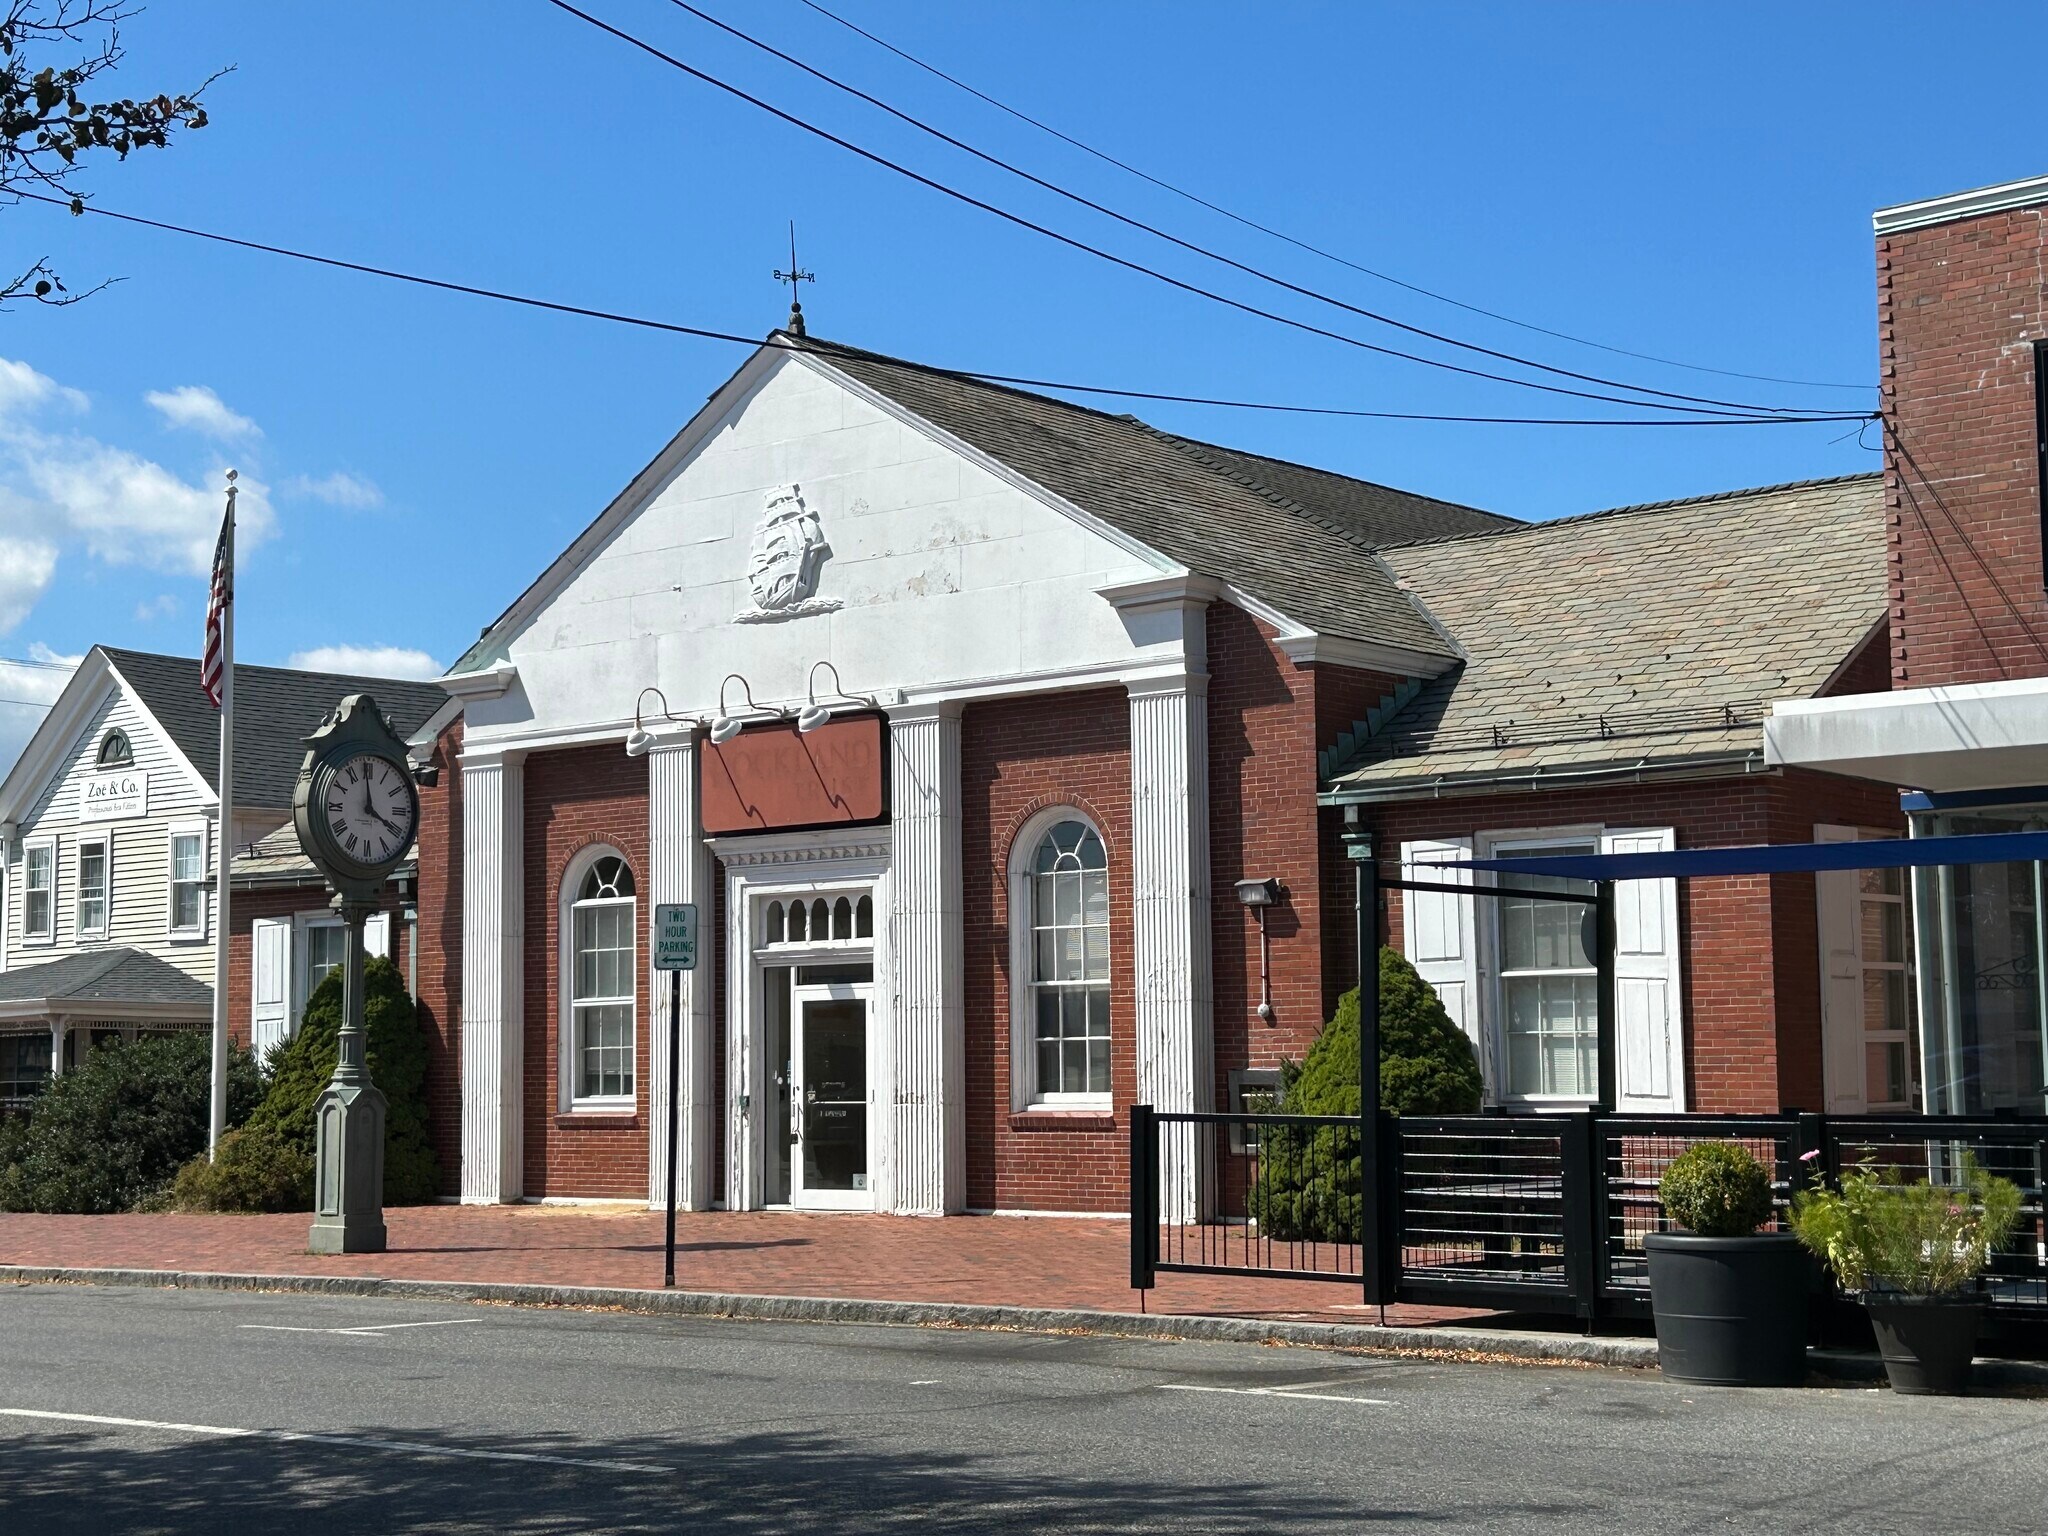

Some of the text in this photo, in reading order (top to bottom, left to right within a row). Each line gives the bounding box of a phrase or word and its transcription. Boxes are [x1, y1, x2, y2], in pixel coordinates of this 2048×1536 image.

[109, 781, 119, 795] &
[121, 778, 138, 794] Co.
[333, 780, 348, 795] X
[668, 910, 686, 922] TWO
[665, 926, 687, 938] HOUR
[658, 941, 694, 953] PARKING
